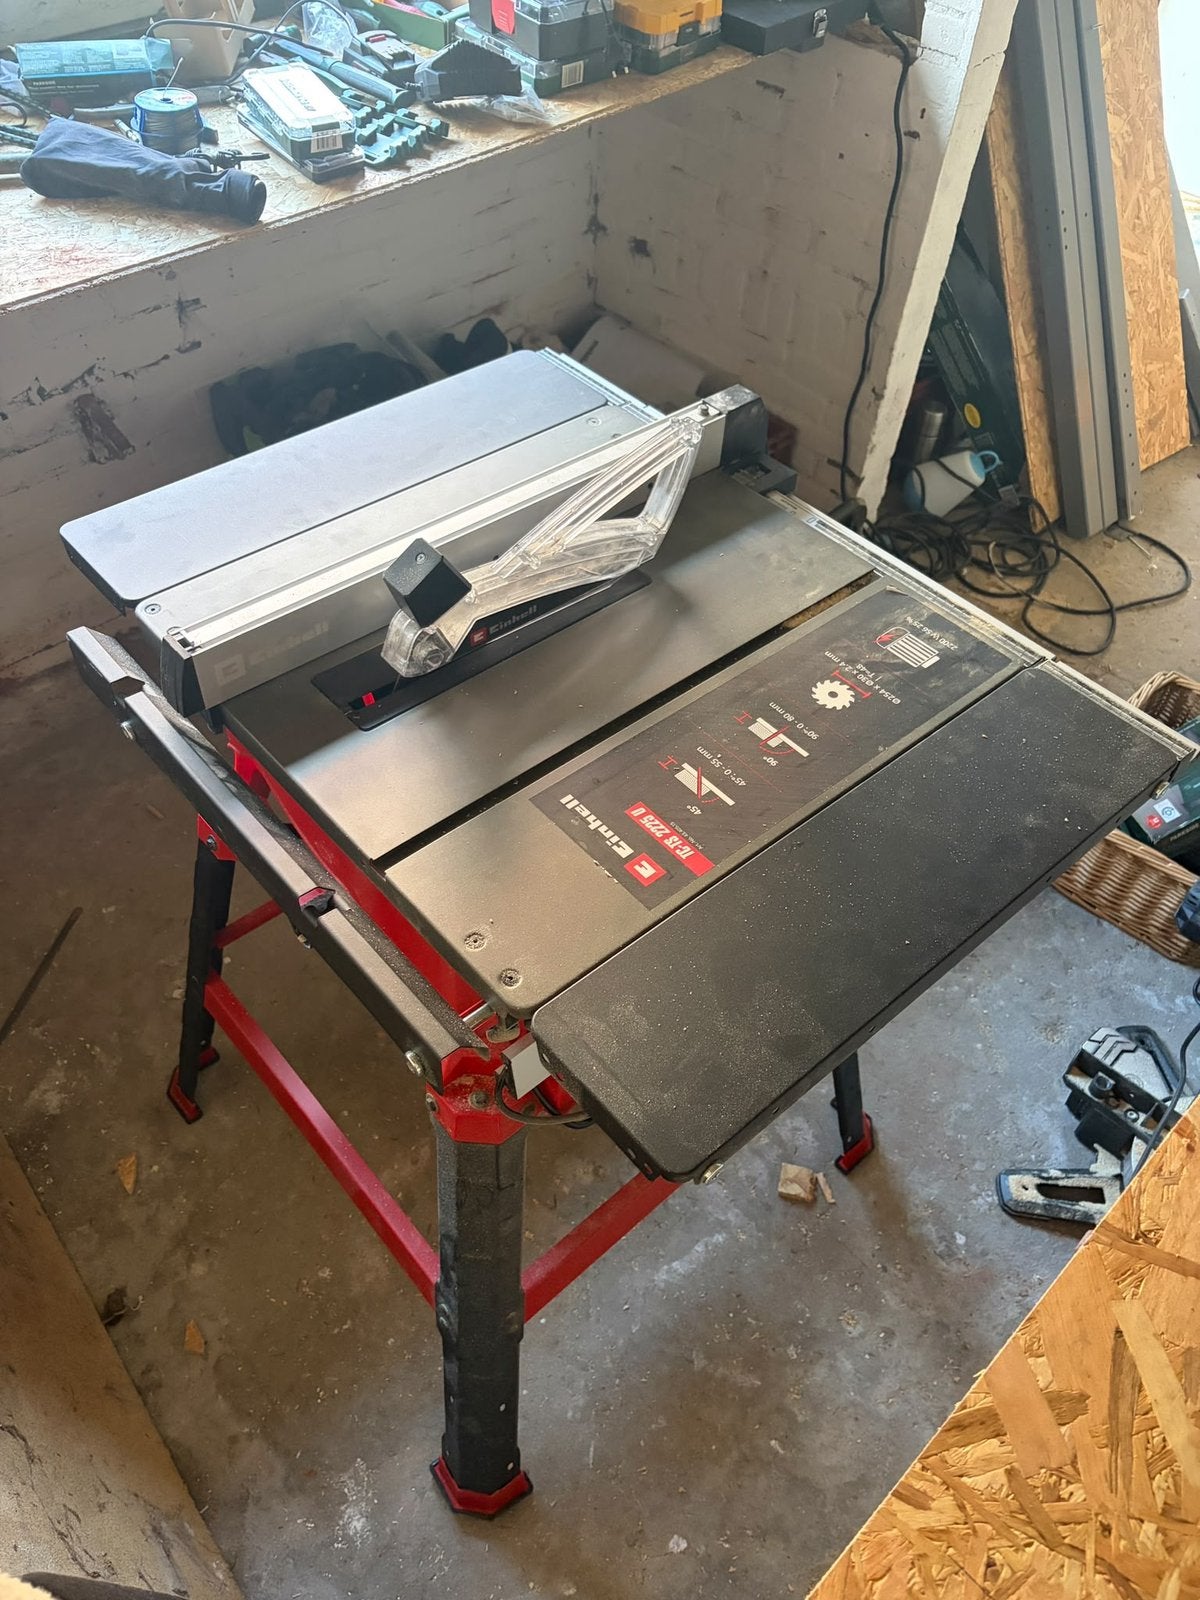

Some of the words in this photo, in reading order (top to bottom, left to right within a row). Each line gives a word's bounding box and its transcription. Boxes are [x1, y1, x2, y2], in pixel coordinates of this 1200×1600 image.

[489, 604, 537, 634] Einhell
[939, 638, 958, 651] 2200
[824, 651, 840, 663] mm
[839, 661, 854, 672] 2.4
[857, 674, 874, 686] Ø30
[879, 688, 901, 705] Ø254
[769, 701, 785, 715] mm
[783, 712, 795, 723] 80
[696, 746, 713, 760] mm
[710, 758, 723, 768] 55
[763, 756, 779, 767] 90°
[630, 807, 643, 817] U
[686, 804, 702, 815] 45°
[559, 794, 634, 859] Einhell
[639, 815, 671, 838] 2225
[663, 835, 695, 860] TC-TS
